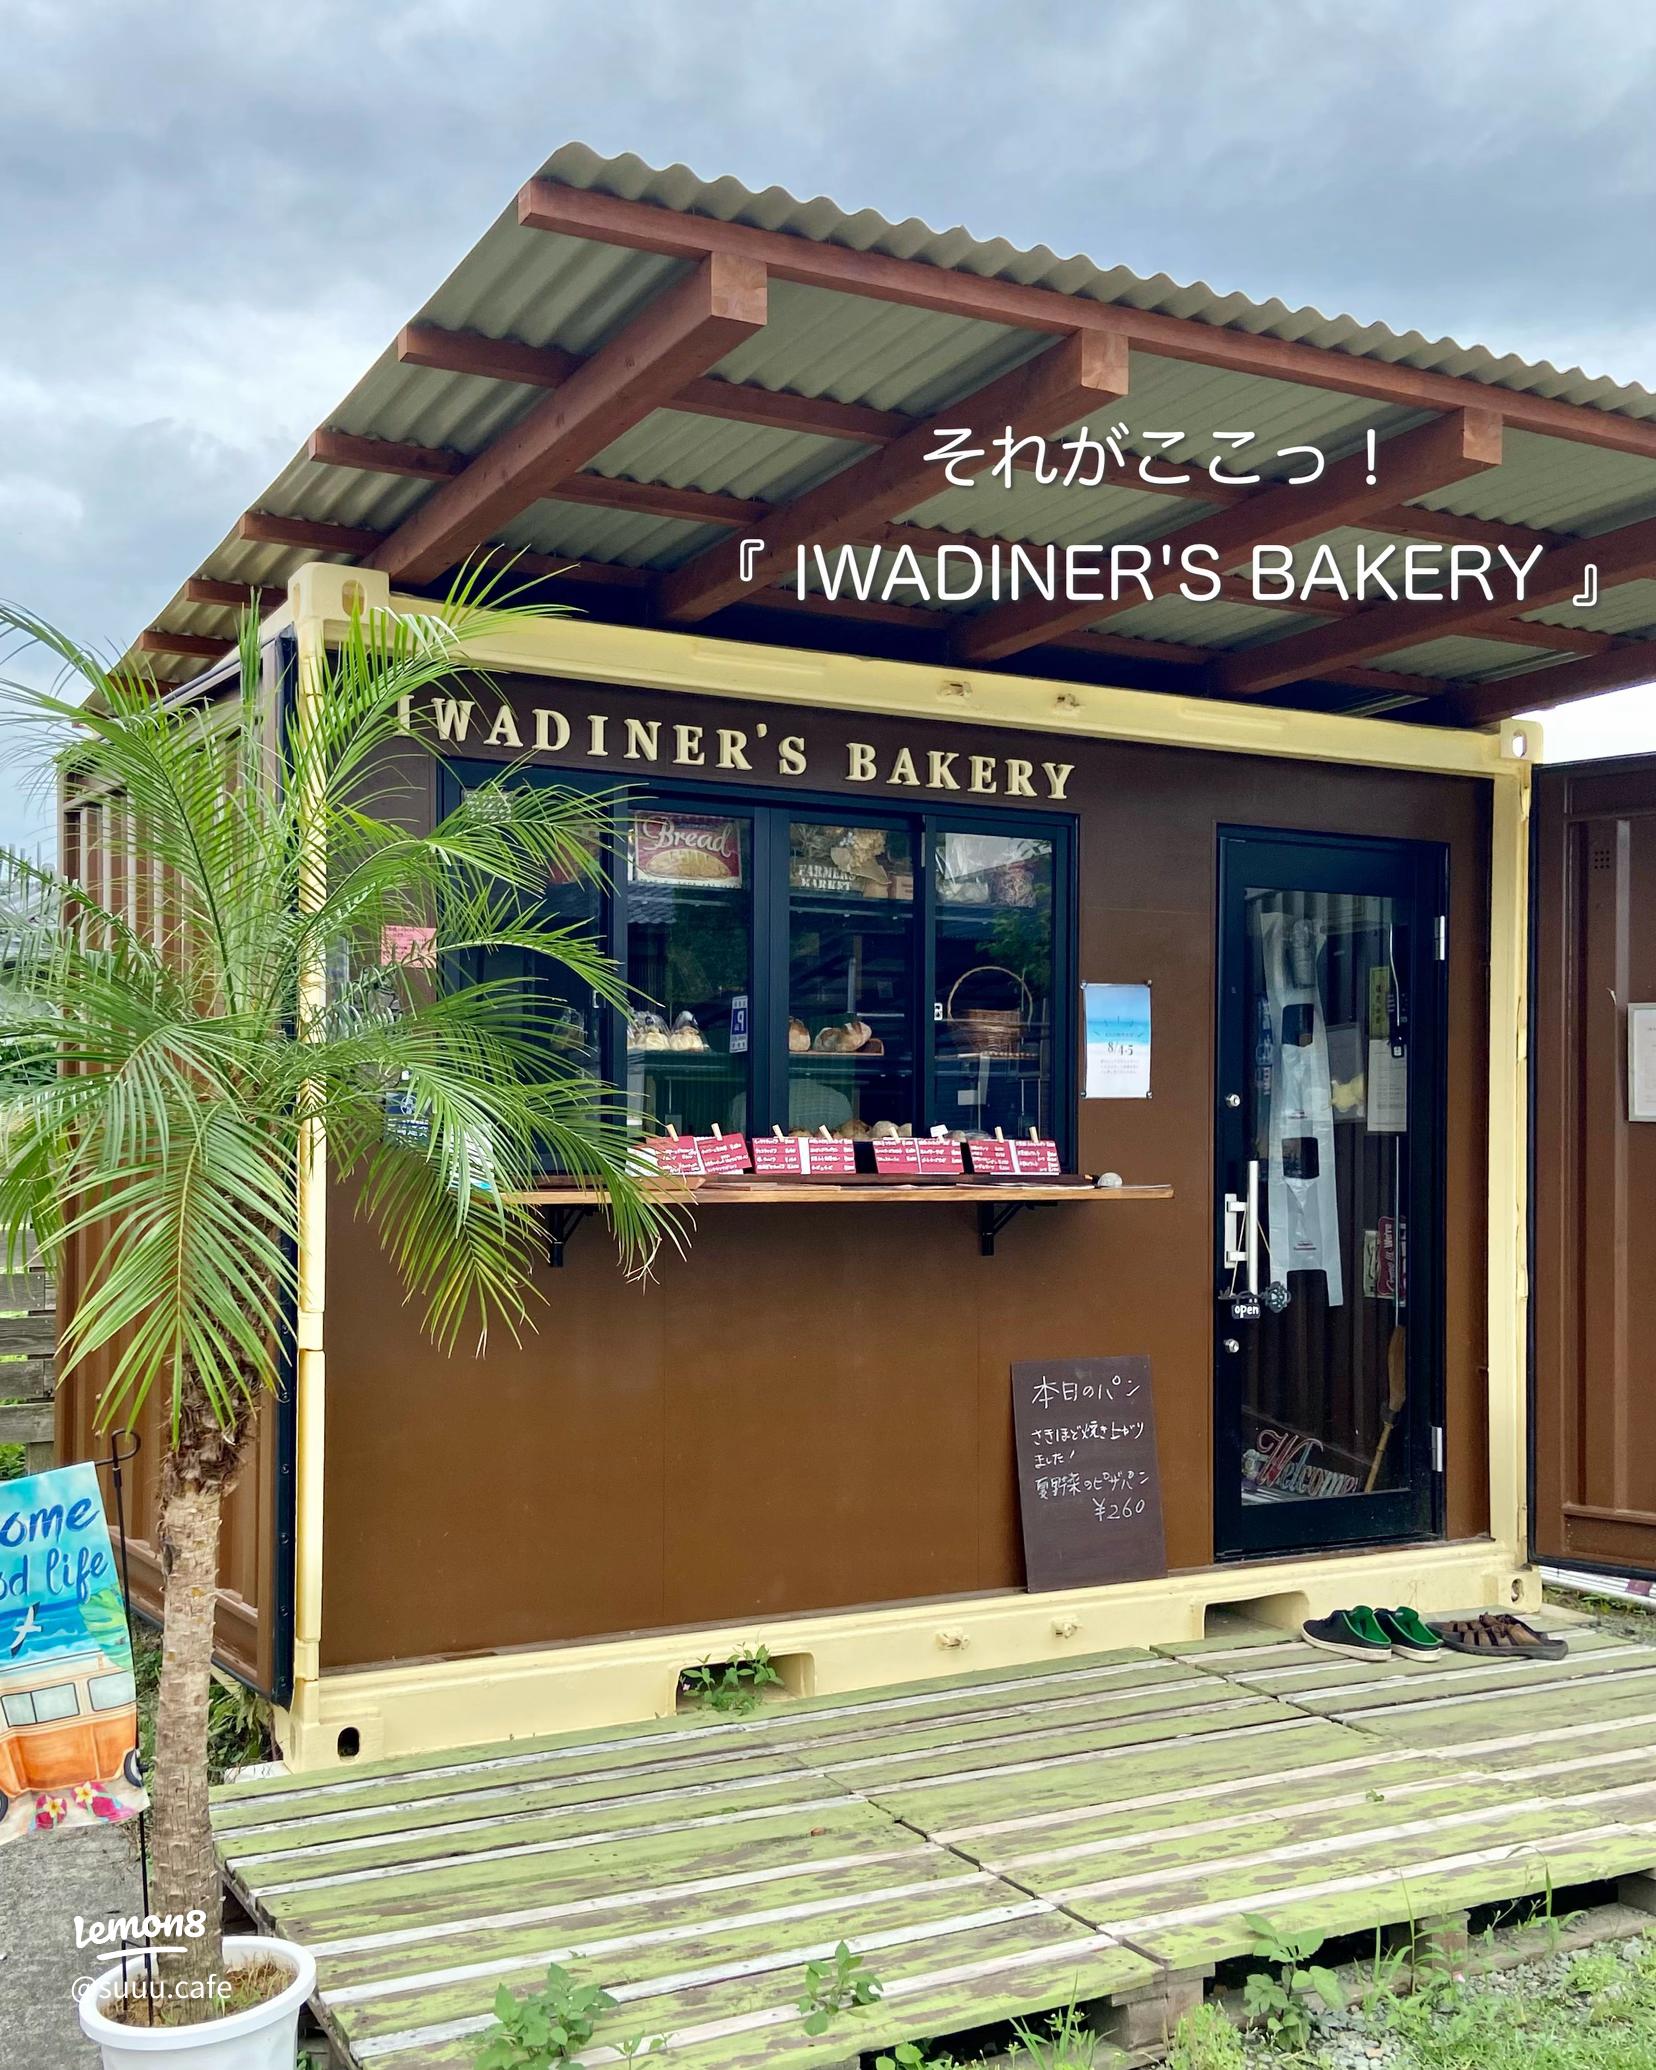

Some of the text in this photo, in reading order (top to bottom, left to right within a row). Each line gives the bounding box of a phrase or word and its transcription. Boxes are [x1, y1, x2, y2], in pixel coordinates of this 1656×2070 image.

[393, 694, 1075, 800] IWADINER'S BAKERY
[641, 816, 732, 858] Bread
[1234, 1304, 1259, 1319] open
[1031, 1375, 1141, 1409] 本日のパン
[47, 1547, 108, 1605] life
